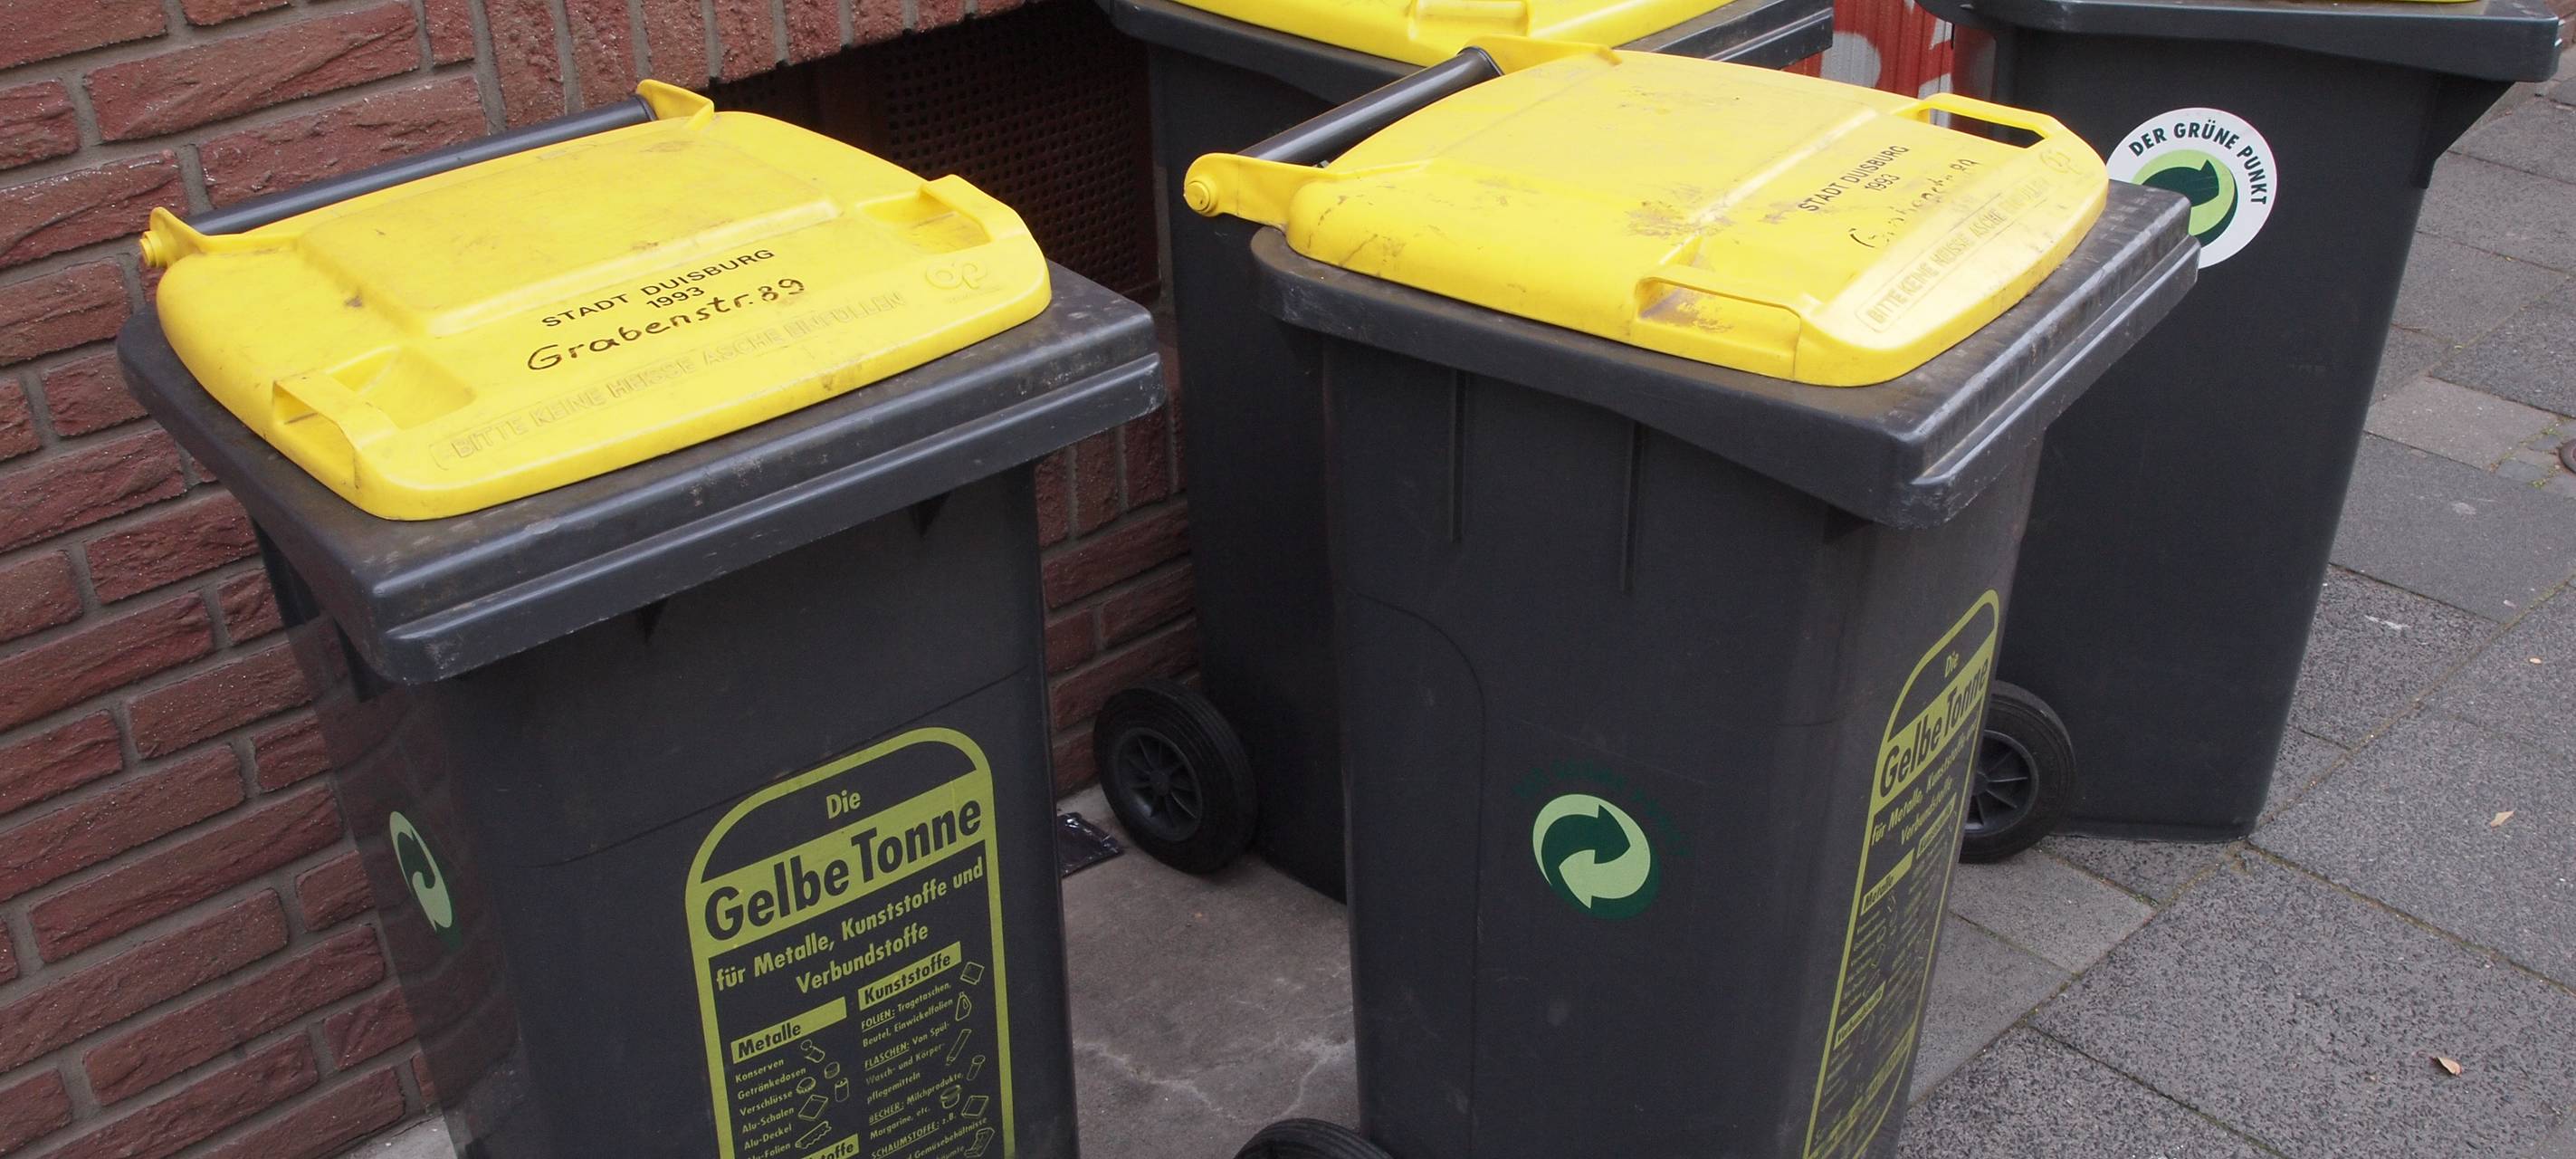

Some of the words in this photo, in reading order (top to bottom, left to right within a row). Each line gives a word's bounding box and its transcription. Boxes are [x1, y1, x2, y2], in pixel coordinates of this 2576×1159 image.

[2129, 128, 2167, 157] DER
[2173, 119, 2240, 149] GRÜNE
[2237, 145, 2268, 205] PUNKT
[1798, 183, 1848, 212] STADT
[1840, 145, 1910, 184] DUISBURG
[1865, 173, 1900, 192] 1993
[542, 293, 630, 327] STADT
[641, 250, 776, 295] DUISBURG
[646, 287, 704, 309] 1993
[452, 417, 529, 458] BITTE
[529, 388, 607, 427] KEINE
[702, 328, 784, 367] ASCHE
[1945, 651, 1960, 678] Die
[825, 790, 862, 820] Die
[1872, 821, 1887, 846] für
[716, 965, 746, 991] für
[753, 932, 835, 978] Metalle,
[841, 878, 948, 942] Kunststoffe
[953, 856, 984, 889] und
[796, 923, 929, 994] Verbundstoffe
[864, 953, 951, 1005] Kunststoffe
[861, 1009, 896, 1030] FOLIEN:
[738, 1022, 801, 1058] Metalle
[862, 1028, 892, 1048] Beutel,
[864, 1040, 910, 1069] FLASCHEN:
[911, 1033, 929, 1046] Von
[735, 1058, 785, 1084] Konserven
[898, 1055, 914, 1070] und
[738, 1067, 807, 1100] Getränkedosen
[867, 1071, 921, 1105] pflegemitteln
[739, 1090, 794, 1116] Verschlüsse
[869, 1101, 905, 1124] BECHER:
[741, 1106, 796, 1134] Alu-Schalen
[744, 1123, 793, 1152] Alu-Deckel
[747, 1142, 792, 1159] lu-Folien
